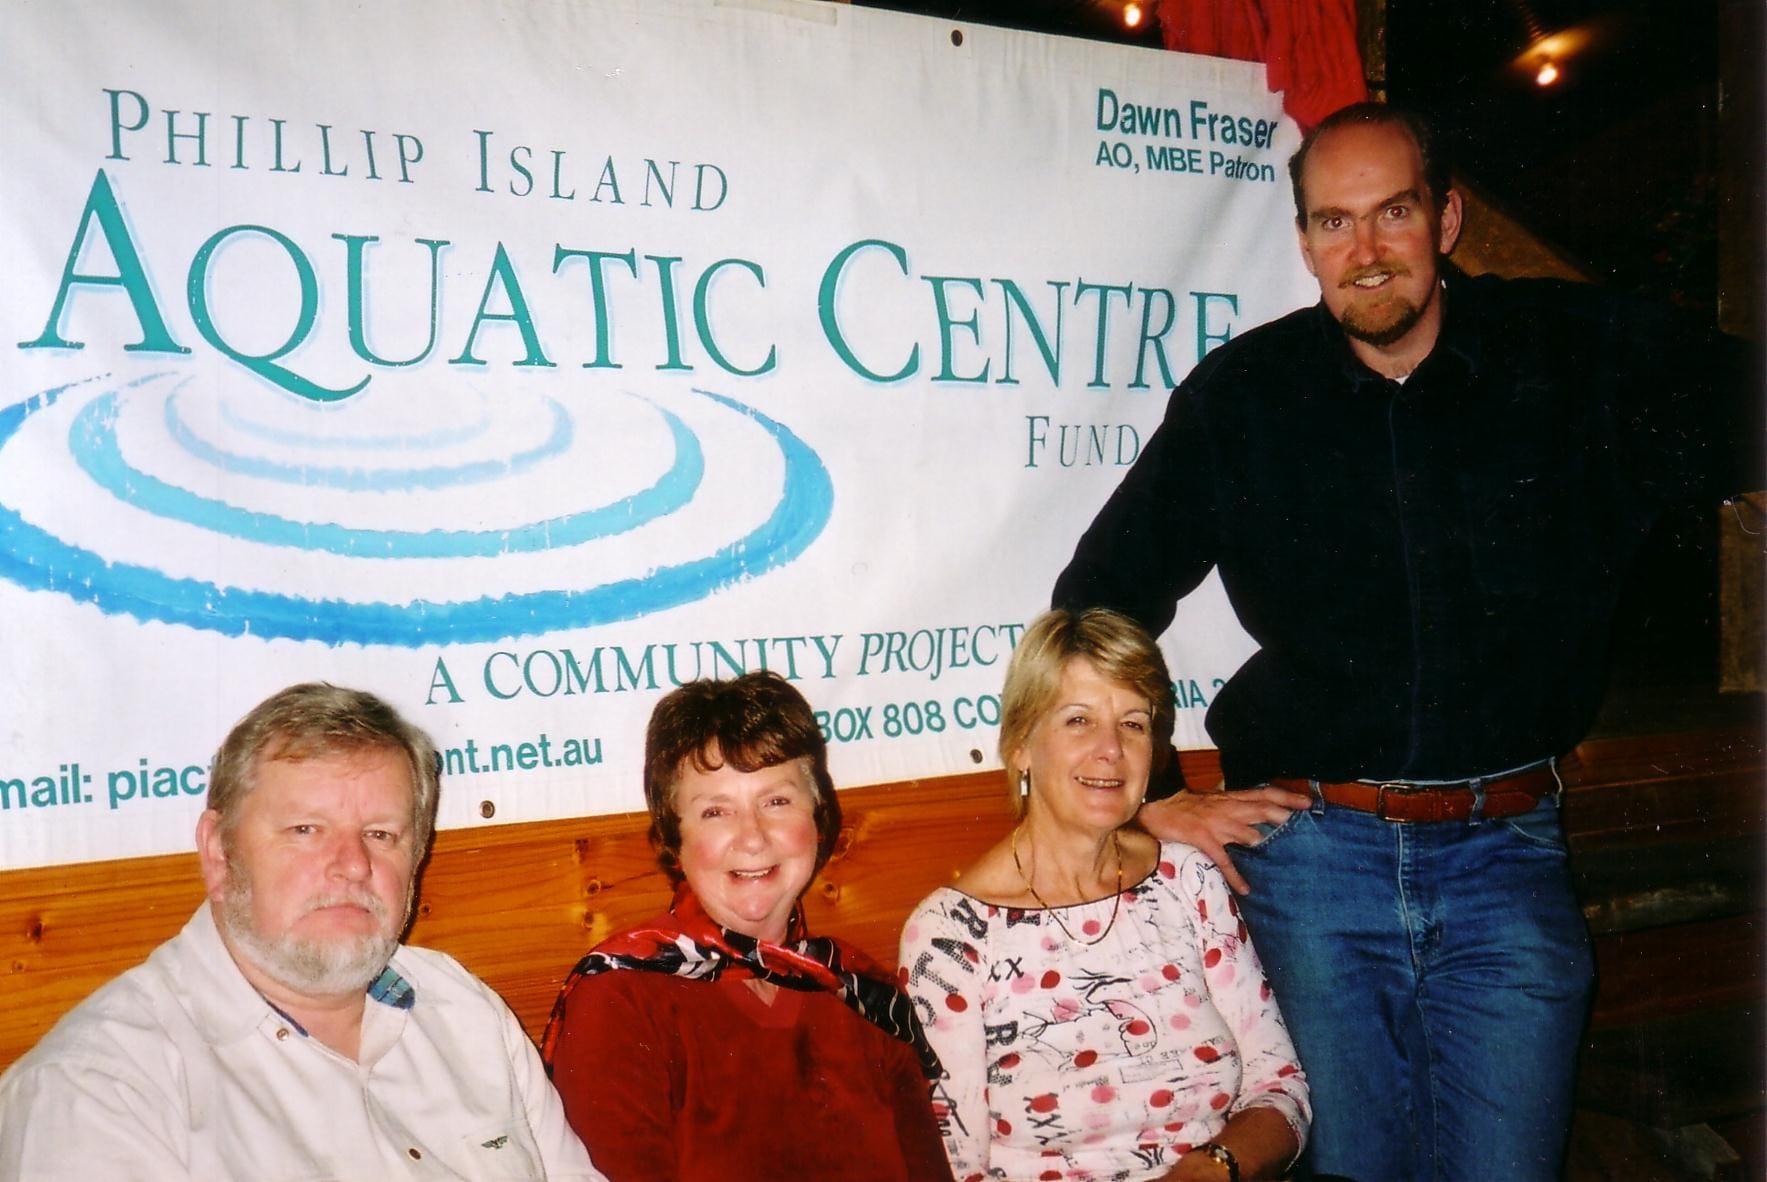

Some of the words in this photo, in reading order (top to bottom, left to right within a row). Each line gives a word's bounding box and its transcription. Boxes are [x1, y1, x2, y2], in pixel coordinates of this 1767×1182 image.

[1097, 88, 1182, 138] Dawn
[1190, 100, 1279, 149] Fraser
[102, 88, 424, 184] PHILLIP
[473, 129, 729, 212] ISLAND
[1096, 141, 1140, 174] AO,
[1146, 145, 1204, 174] MBE
[1209, 151, 1275, 182] Patron
[17, 167, 778, 402] AQUATIC
[425, 656, 465, 705] A
[484, 635, 843, 700] COMMUNITY
[883, 700, 946, 738] 808
[953, 693, 1003, 729] CO
[108, 758, 211, 810] piac
